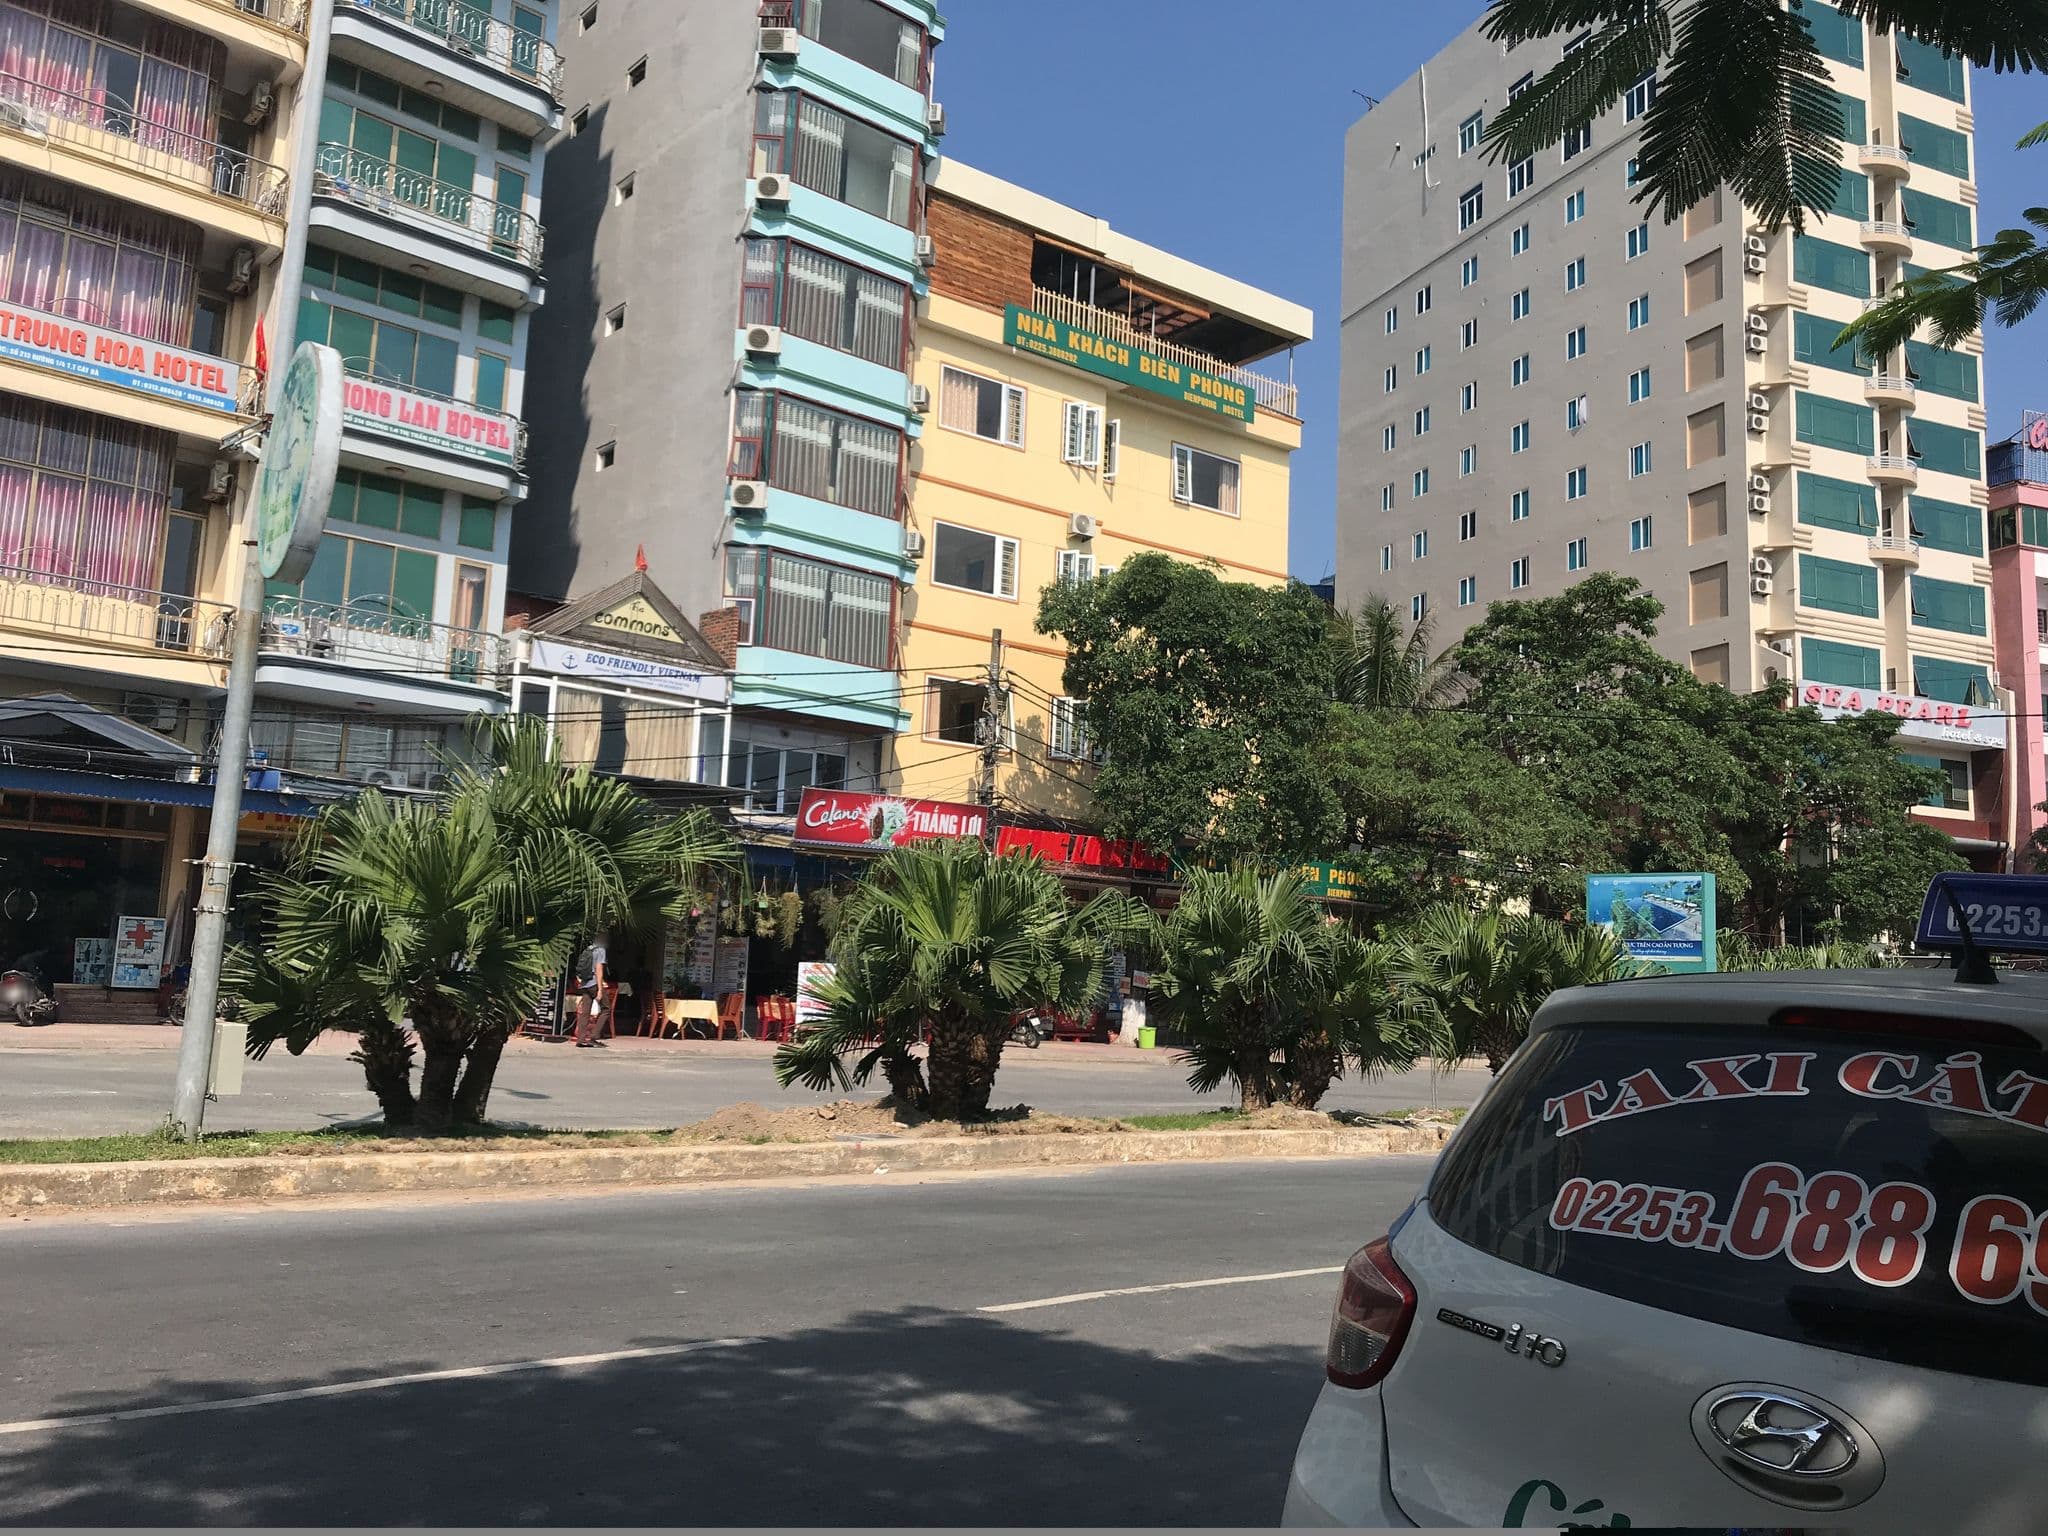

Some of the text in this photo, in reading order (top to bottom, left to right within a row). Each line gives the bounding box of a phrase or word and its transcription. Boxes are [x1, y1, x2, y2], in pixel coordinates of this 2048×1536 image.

[0, 310, 227, 393] TRUNG HOA HOTEL
[1017, 312, 1245, 406] NHÀ KHÁCH BIÊN PHÒNG
[398, 397, 440, 431] LAN
[446, 410, 510, 449] HOTEL
[585, 653, 605, 665] ECO
[607, 656, 656, 674] FRIENDLY
[658, 667, 701, 684] VIETNAM
[1804, 685, 1973, 728] SEA PEARL
[1942, 726, 1973, 742] hotel
[1983, 736, 2004, 747] spa
[805, 799, 862, 827] Celano
[913, 805, 957, 835] THẮNG
[1544, 1052, 1818, 1137] TAXI
[1438, 1310, 1567, 1368] GRAND i10
